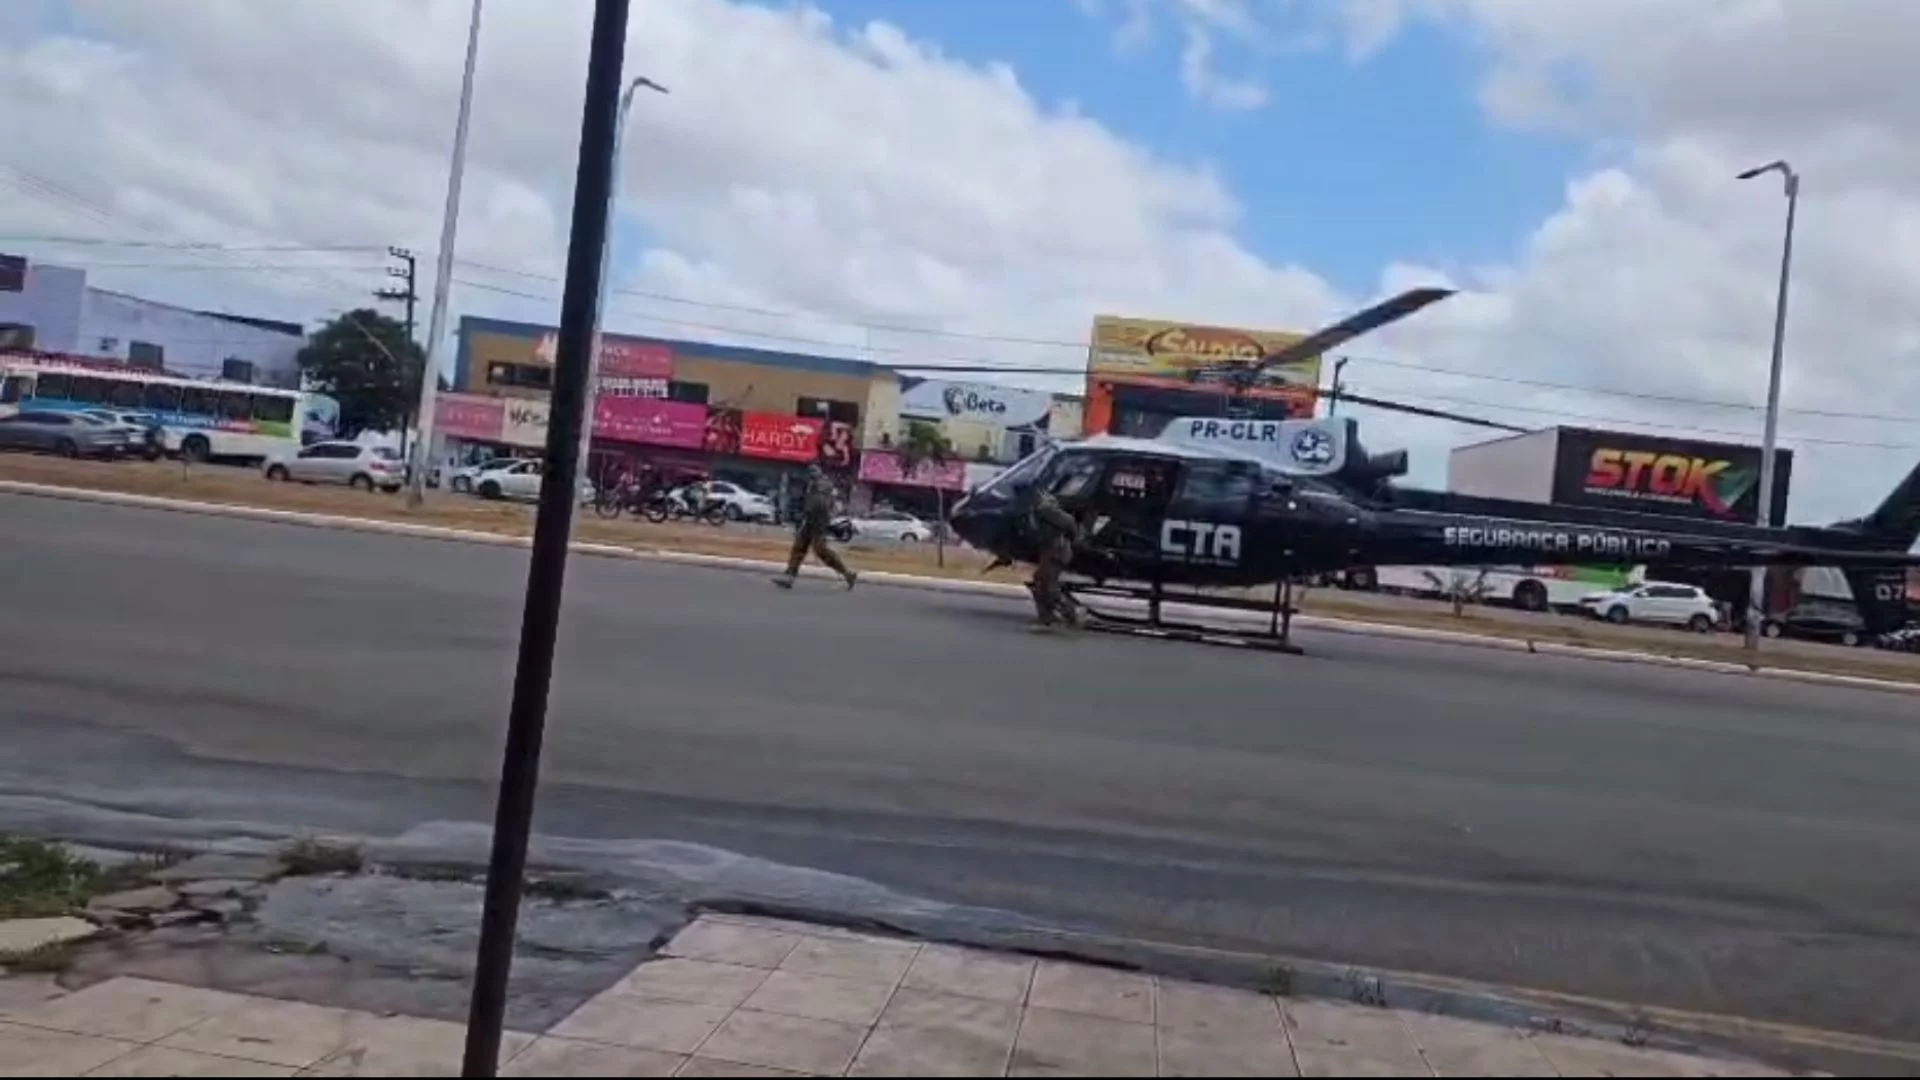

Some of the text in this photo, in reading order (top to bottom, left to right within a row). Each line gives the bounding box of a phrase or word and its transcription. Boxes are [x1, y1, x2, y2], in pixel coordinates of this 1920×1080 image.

[966, 392, 1006, 413] Beta
[742, 427, 810, 449] HARDY
[1190, 420, 1277, 442] PR-CLR
[1585, 448, 1738, 518] STOK
[1160, 519, 1241, 560] CTA
